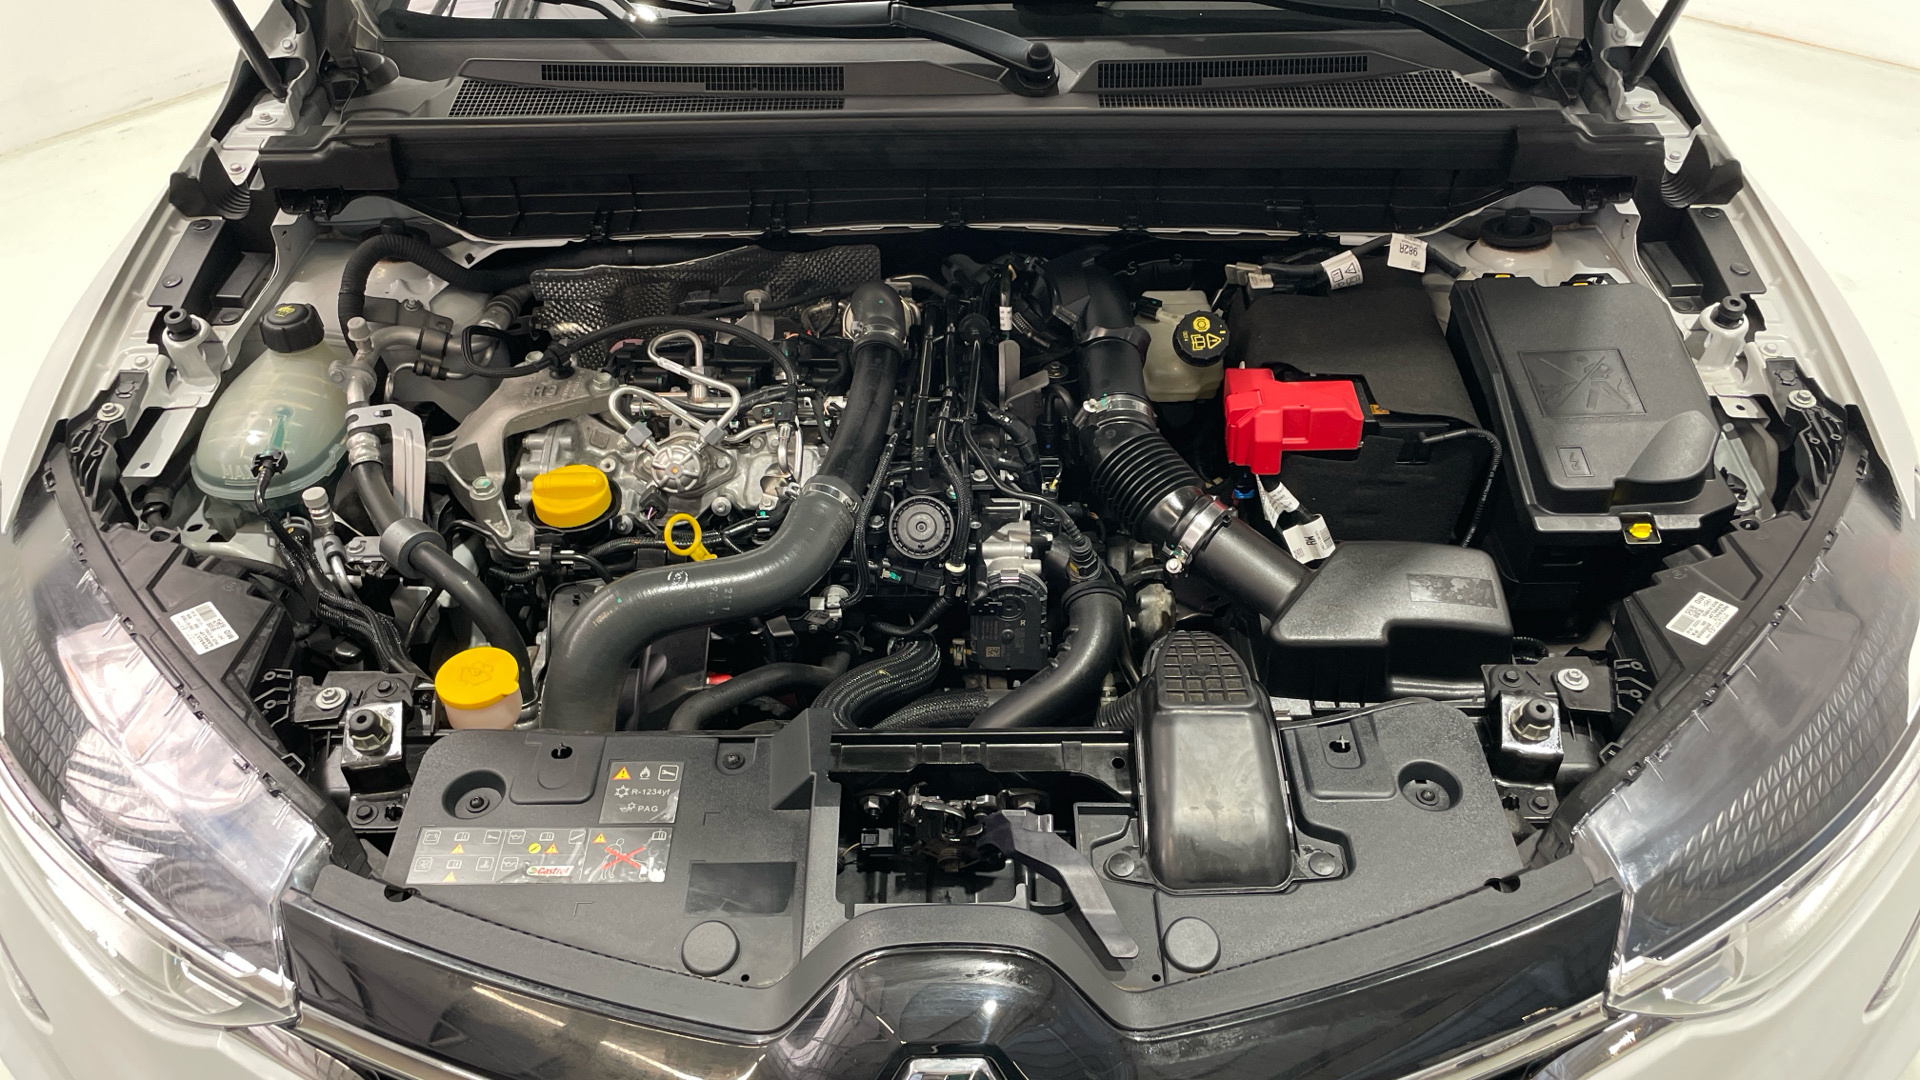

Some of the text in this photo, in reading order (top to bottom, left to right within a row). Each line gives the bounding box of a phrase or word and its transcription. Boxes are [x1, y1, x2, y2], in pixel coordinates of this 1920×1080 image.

[1400, 243, 1418, 257] 982R
[631, 788, 671, 797] R-1234yf
[637, 805, 659, 813] PAG
[537, 867, 570, 875] Castrol
